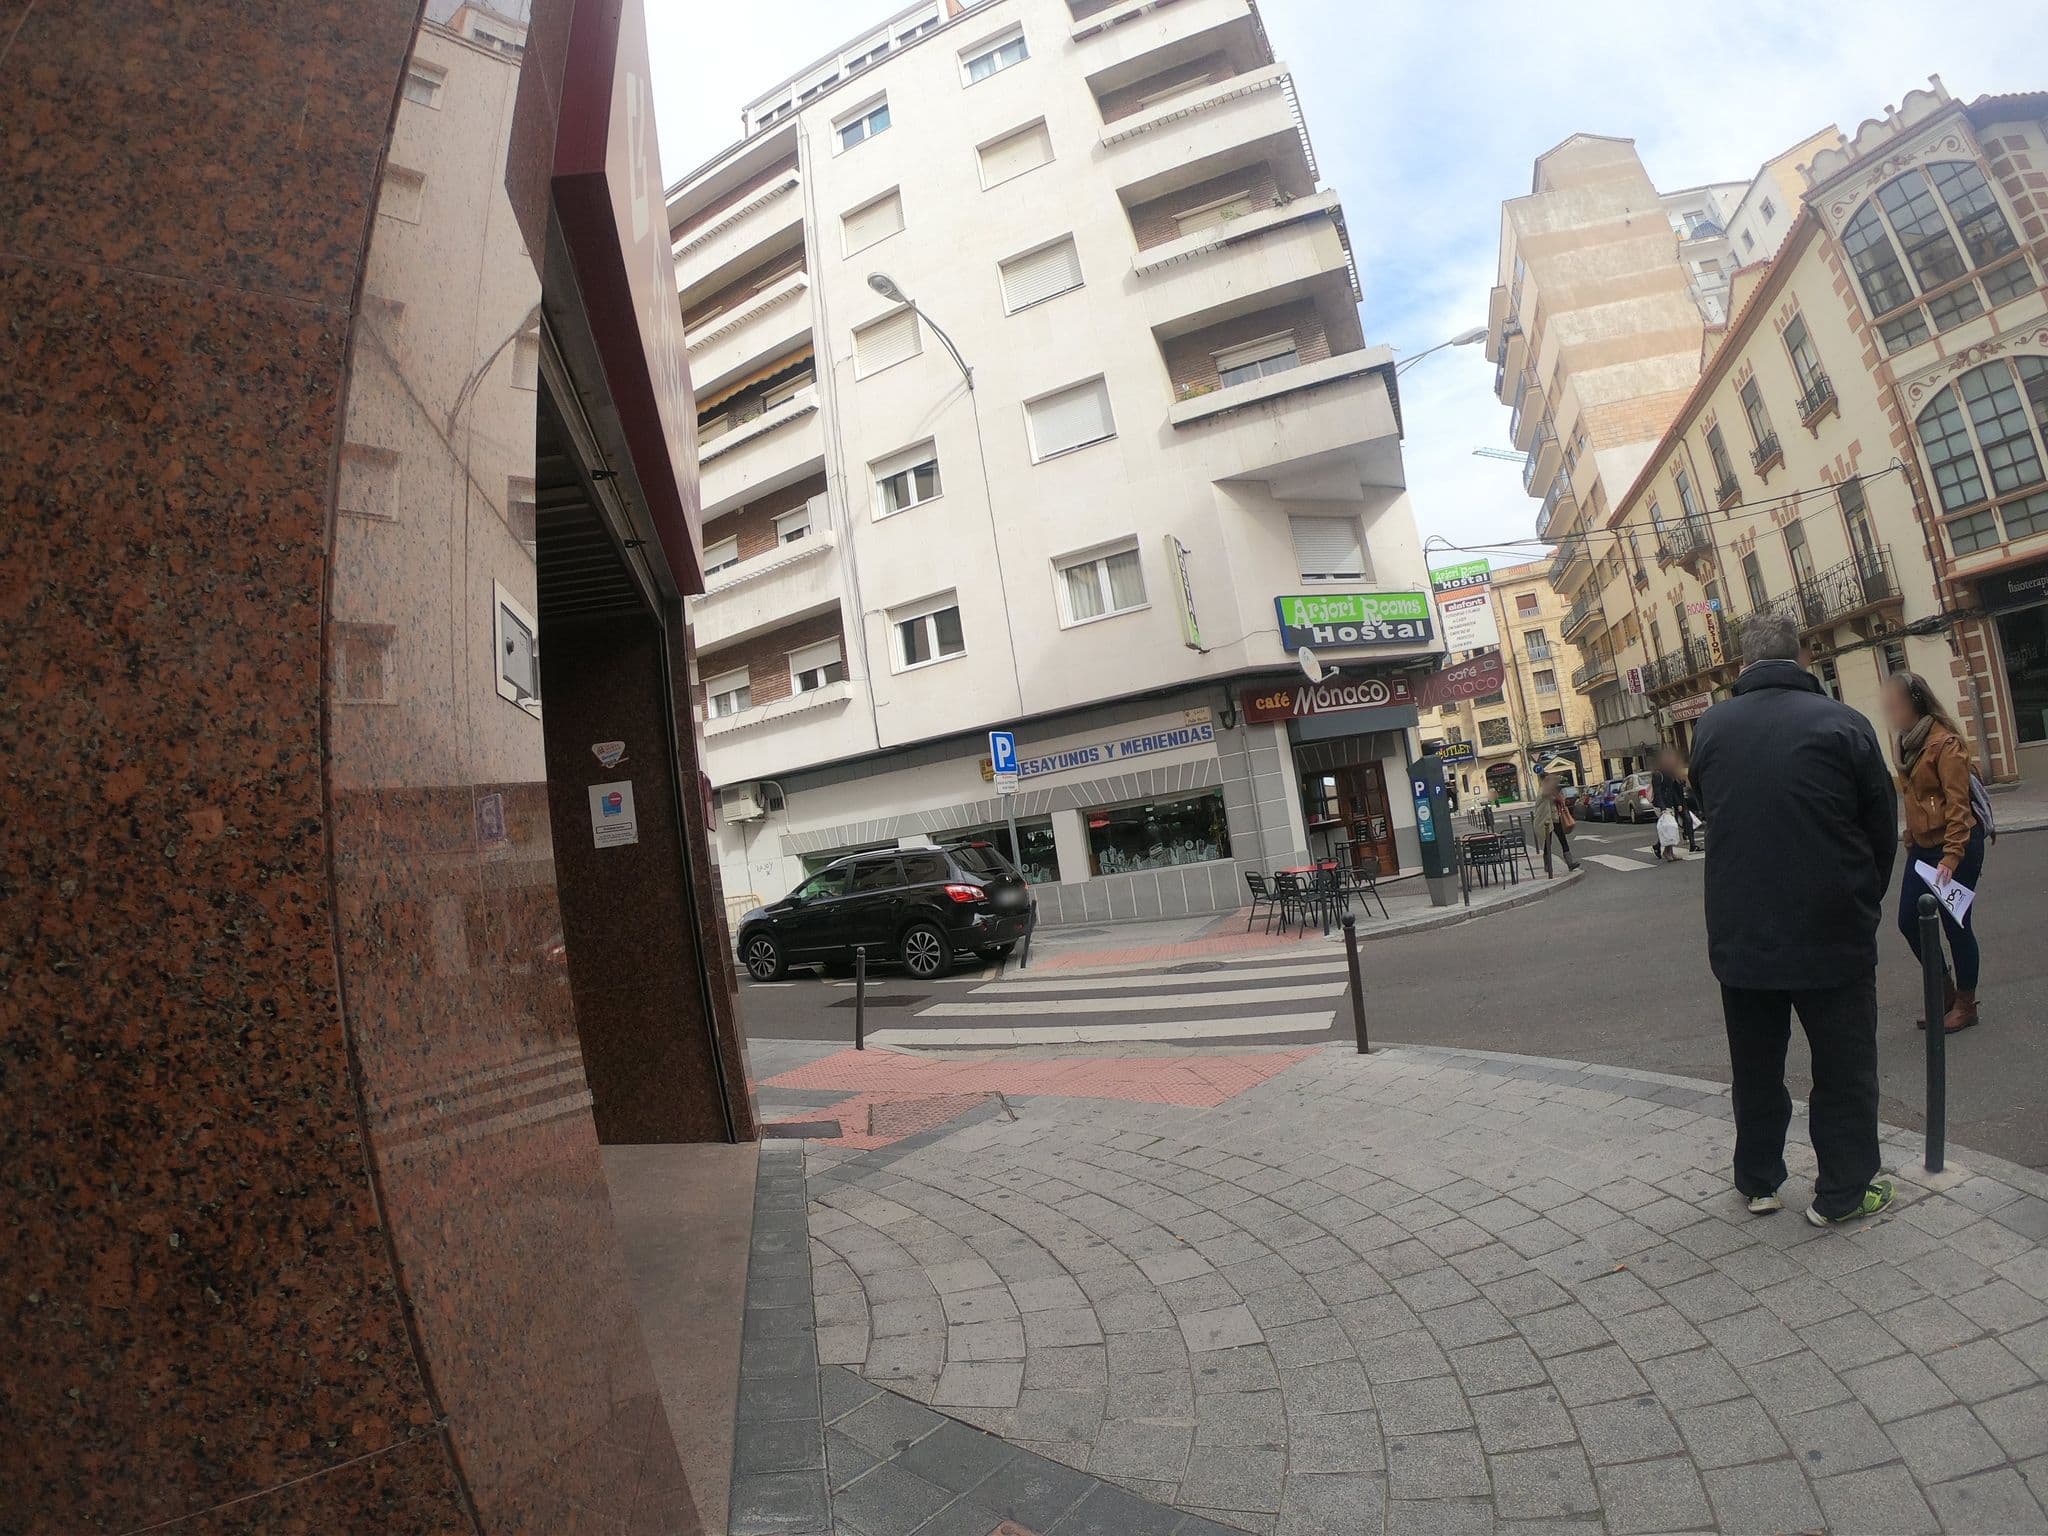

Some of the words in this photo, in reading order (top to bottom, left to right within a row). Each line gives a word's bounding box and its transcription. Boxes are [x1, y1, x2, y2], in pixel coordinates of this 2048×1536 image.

[1442, 573, 1488, 590] Hostal
[1292, 595, 1357, 629] Arjori
[1360, 597, 1421, 627] Rooms
[1312, 620, 1426, 644] Hostal
[1447, 666, 1478, 682] café
[1255, 692, 1291, 711] café
[1293, 681, 1389, 716] Mónaco
[1422, 676, 1498, 706] Mónaco
[996, 736, 1011, 768] P
[1104, 744, 1115, 759] Y
[1120, 724, 1213, 756] MERIENDAS
[1414, 781, 1425, 797] P
[1435, 786, 1441, 795] P
